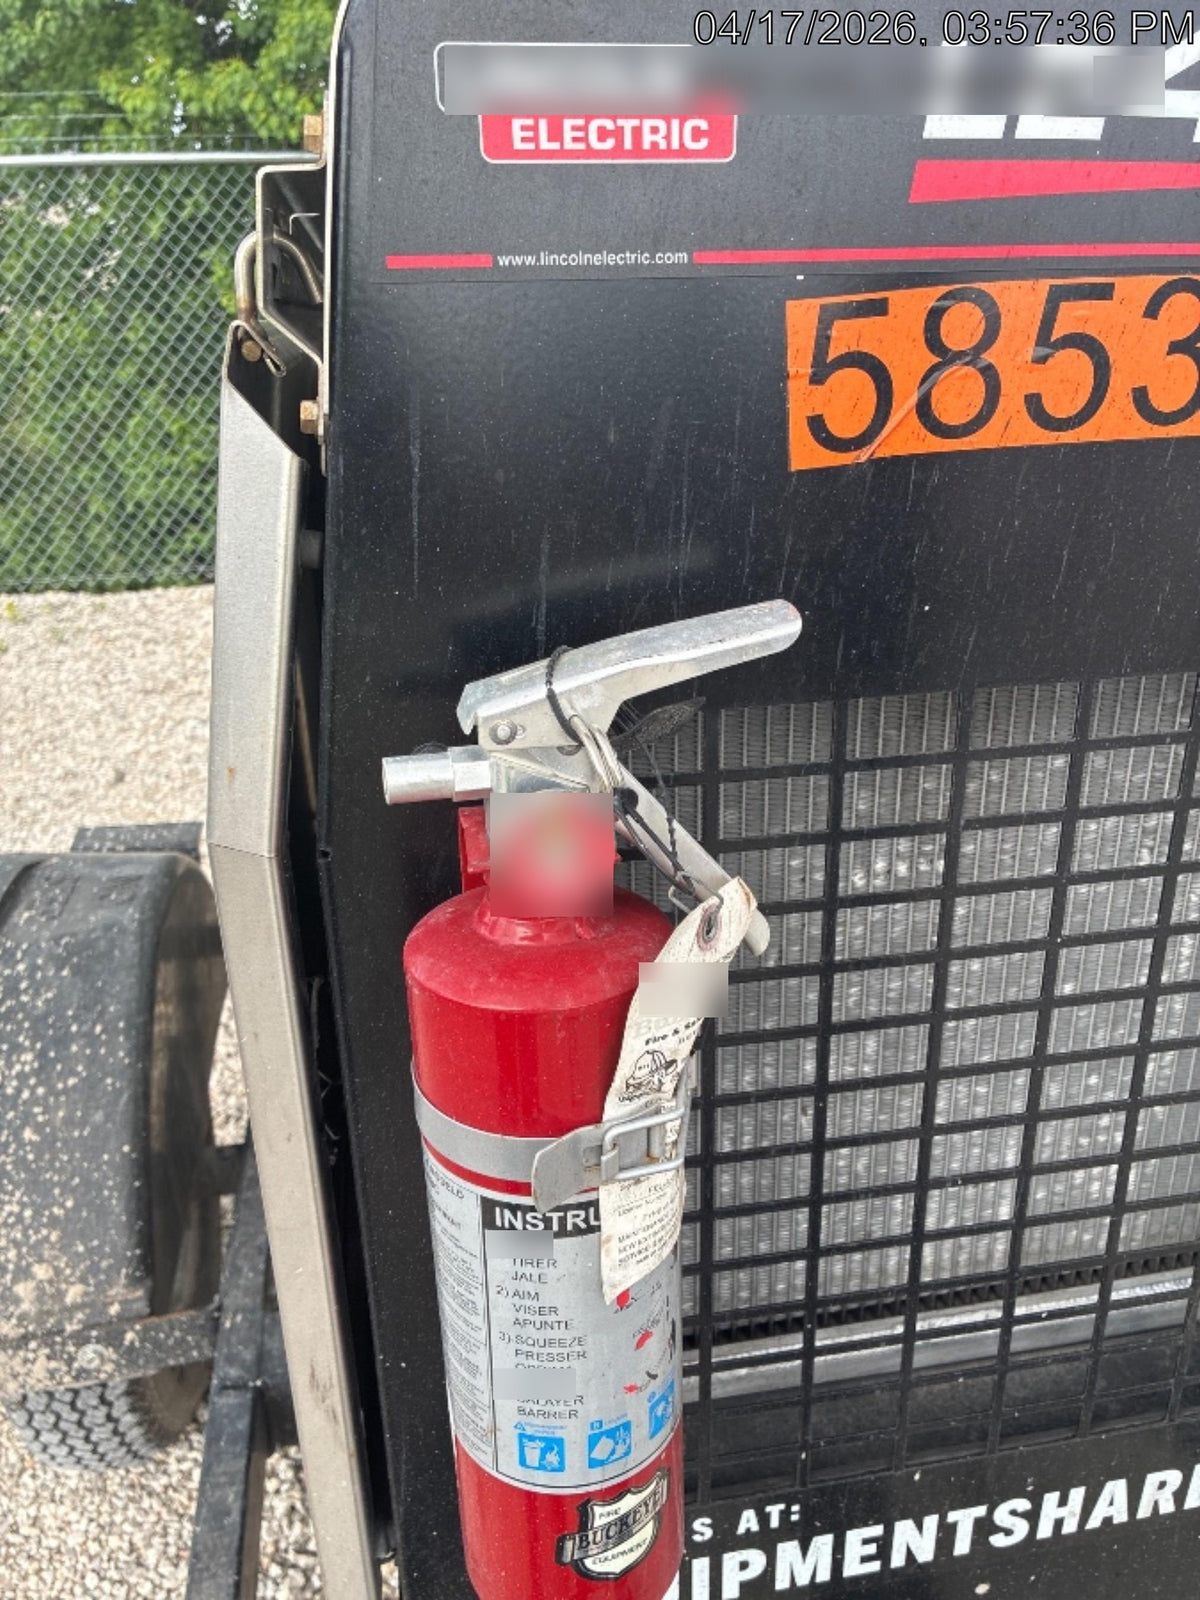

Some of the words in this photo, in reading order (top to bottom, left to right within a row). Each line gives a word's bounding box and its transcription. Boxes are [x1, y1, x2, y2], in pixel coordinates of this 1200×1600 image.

[511, 118, 709, 150] ELECTRIC
[497, 250, 688, 267] www.lincolnelectric.com
[806, 277, 1200, 453] 5853
[511, 1271, 549, 1284] JALE
[512, 1303, 559, 1316] VISER
[513, 1317, 575, 1331] APUNTE
[514, 1349, 588, 1362] PRESSER
[516, 1406, 579, 1419] BARRER
[736, 1503, 800, 1535] AT:
[662, 1463, 1200, 1600] IPMENTSHAR
